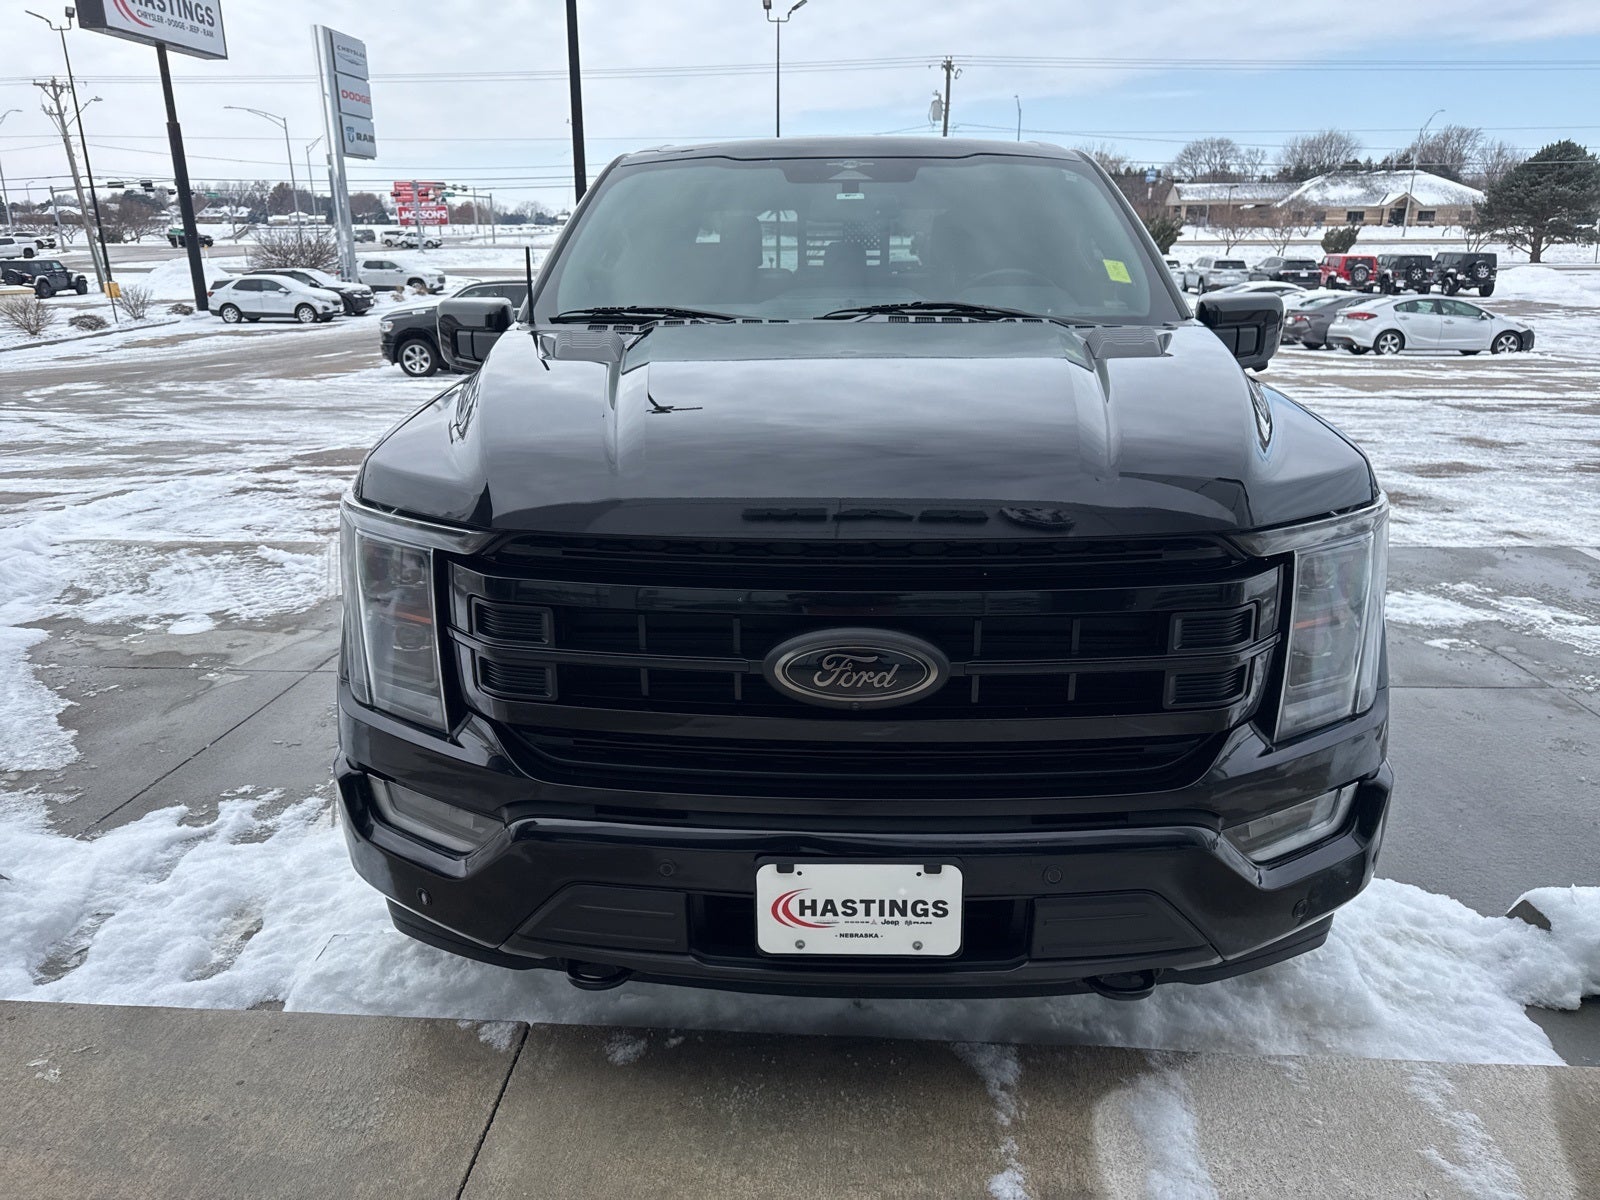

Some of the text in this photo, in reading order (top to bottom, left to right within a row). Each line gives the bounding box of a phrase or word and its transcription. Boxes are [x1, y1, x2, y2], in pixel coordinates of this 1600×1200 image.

[131, 0, 215, 27] STINGS
[137, 9, 165, 24] CHRYSLER
[189, 25, 200, 34] JEEP
[341, 89, 371, 105] DODGE
[356, 132, 375, 144] RAM
[813, 653, 900, 688] Ford
[799, 899, 949, 918] HASTINGS
